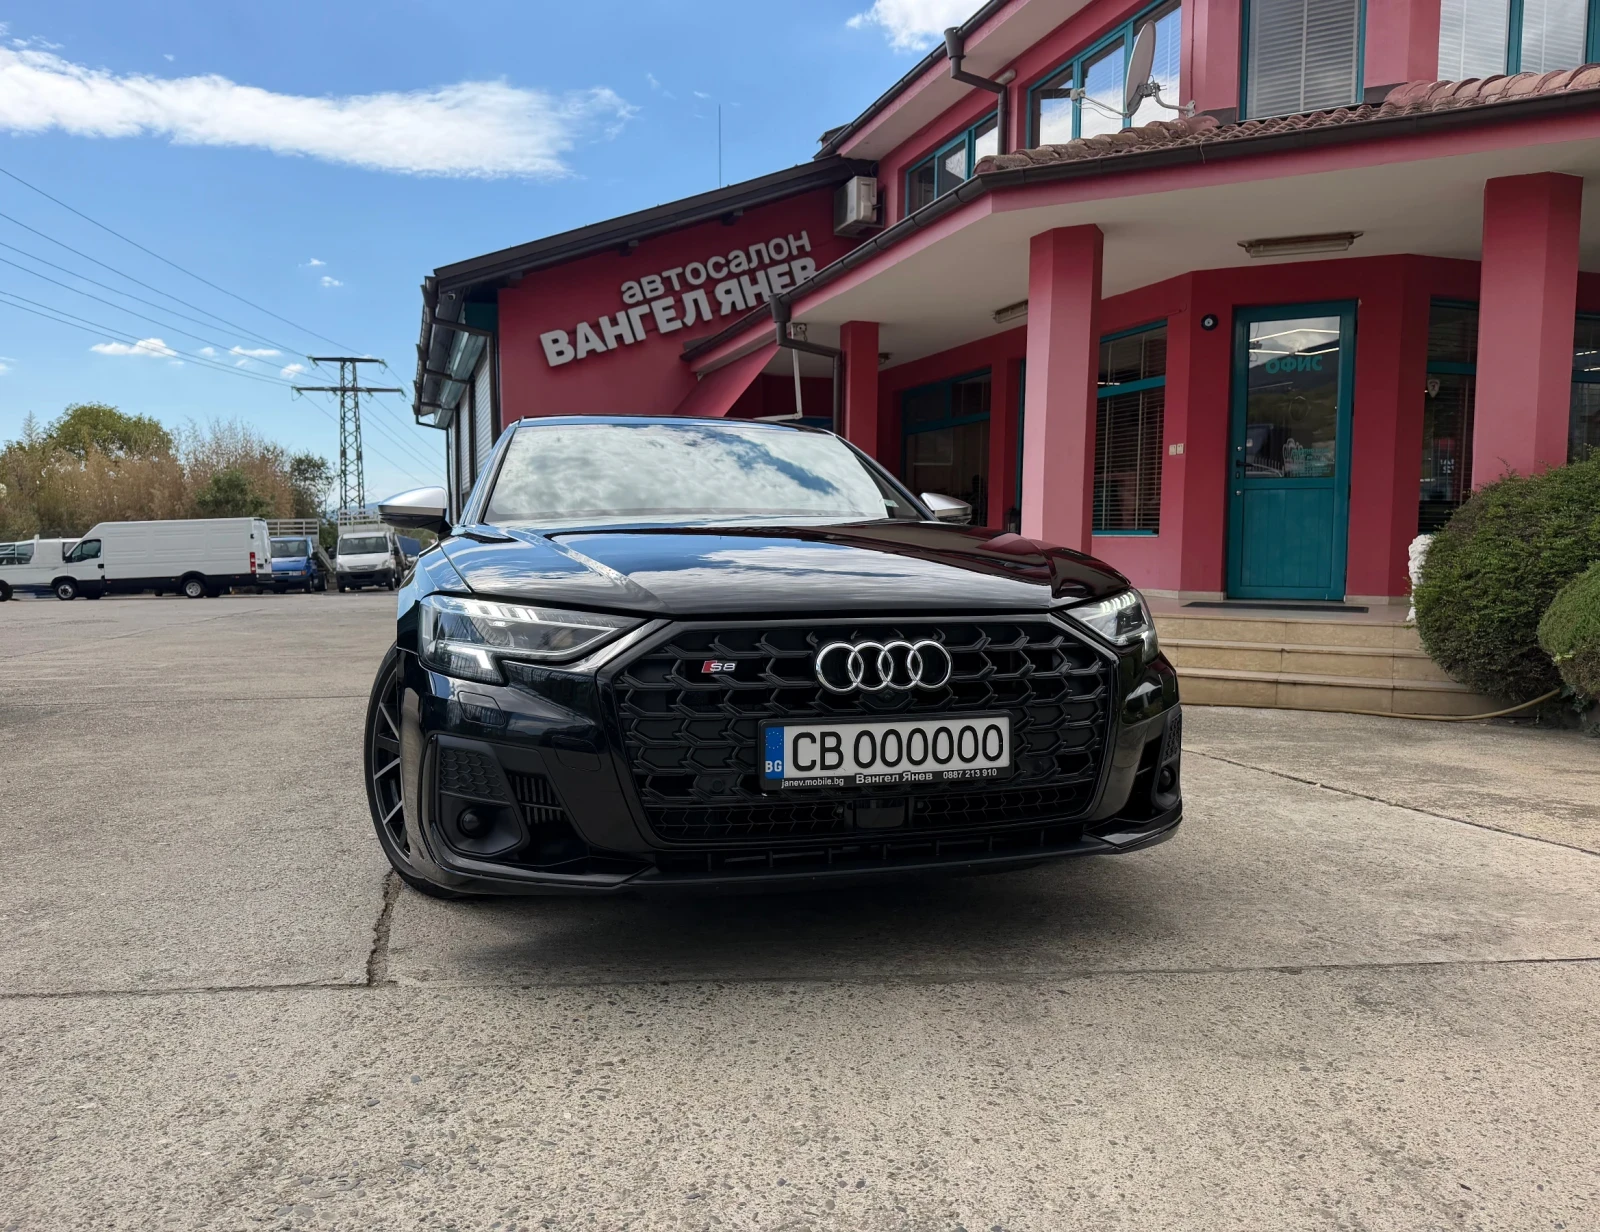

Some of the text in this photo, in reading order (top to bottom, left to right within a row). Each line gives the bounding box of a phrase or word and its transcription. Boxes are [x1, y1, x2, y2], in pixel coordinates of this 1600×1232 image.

[620, 230, 811, 304] автосалон
[540, 289, 713, 367] ВАНГЕЛ
[1265, 355, 1323, 374] ОФИС
[710, 662, 736, 672] S8
[853, 724, 1004, 769] 000000
[765, 760, 783, 773] BG
[855, 771, 933, 784] Вангел Янев
[942, 768, 997, 779] 0887 213 910
[781, 777, 844, 789] janev.mobile.bg
